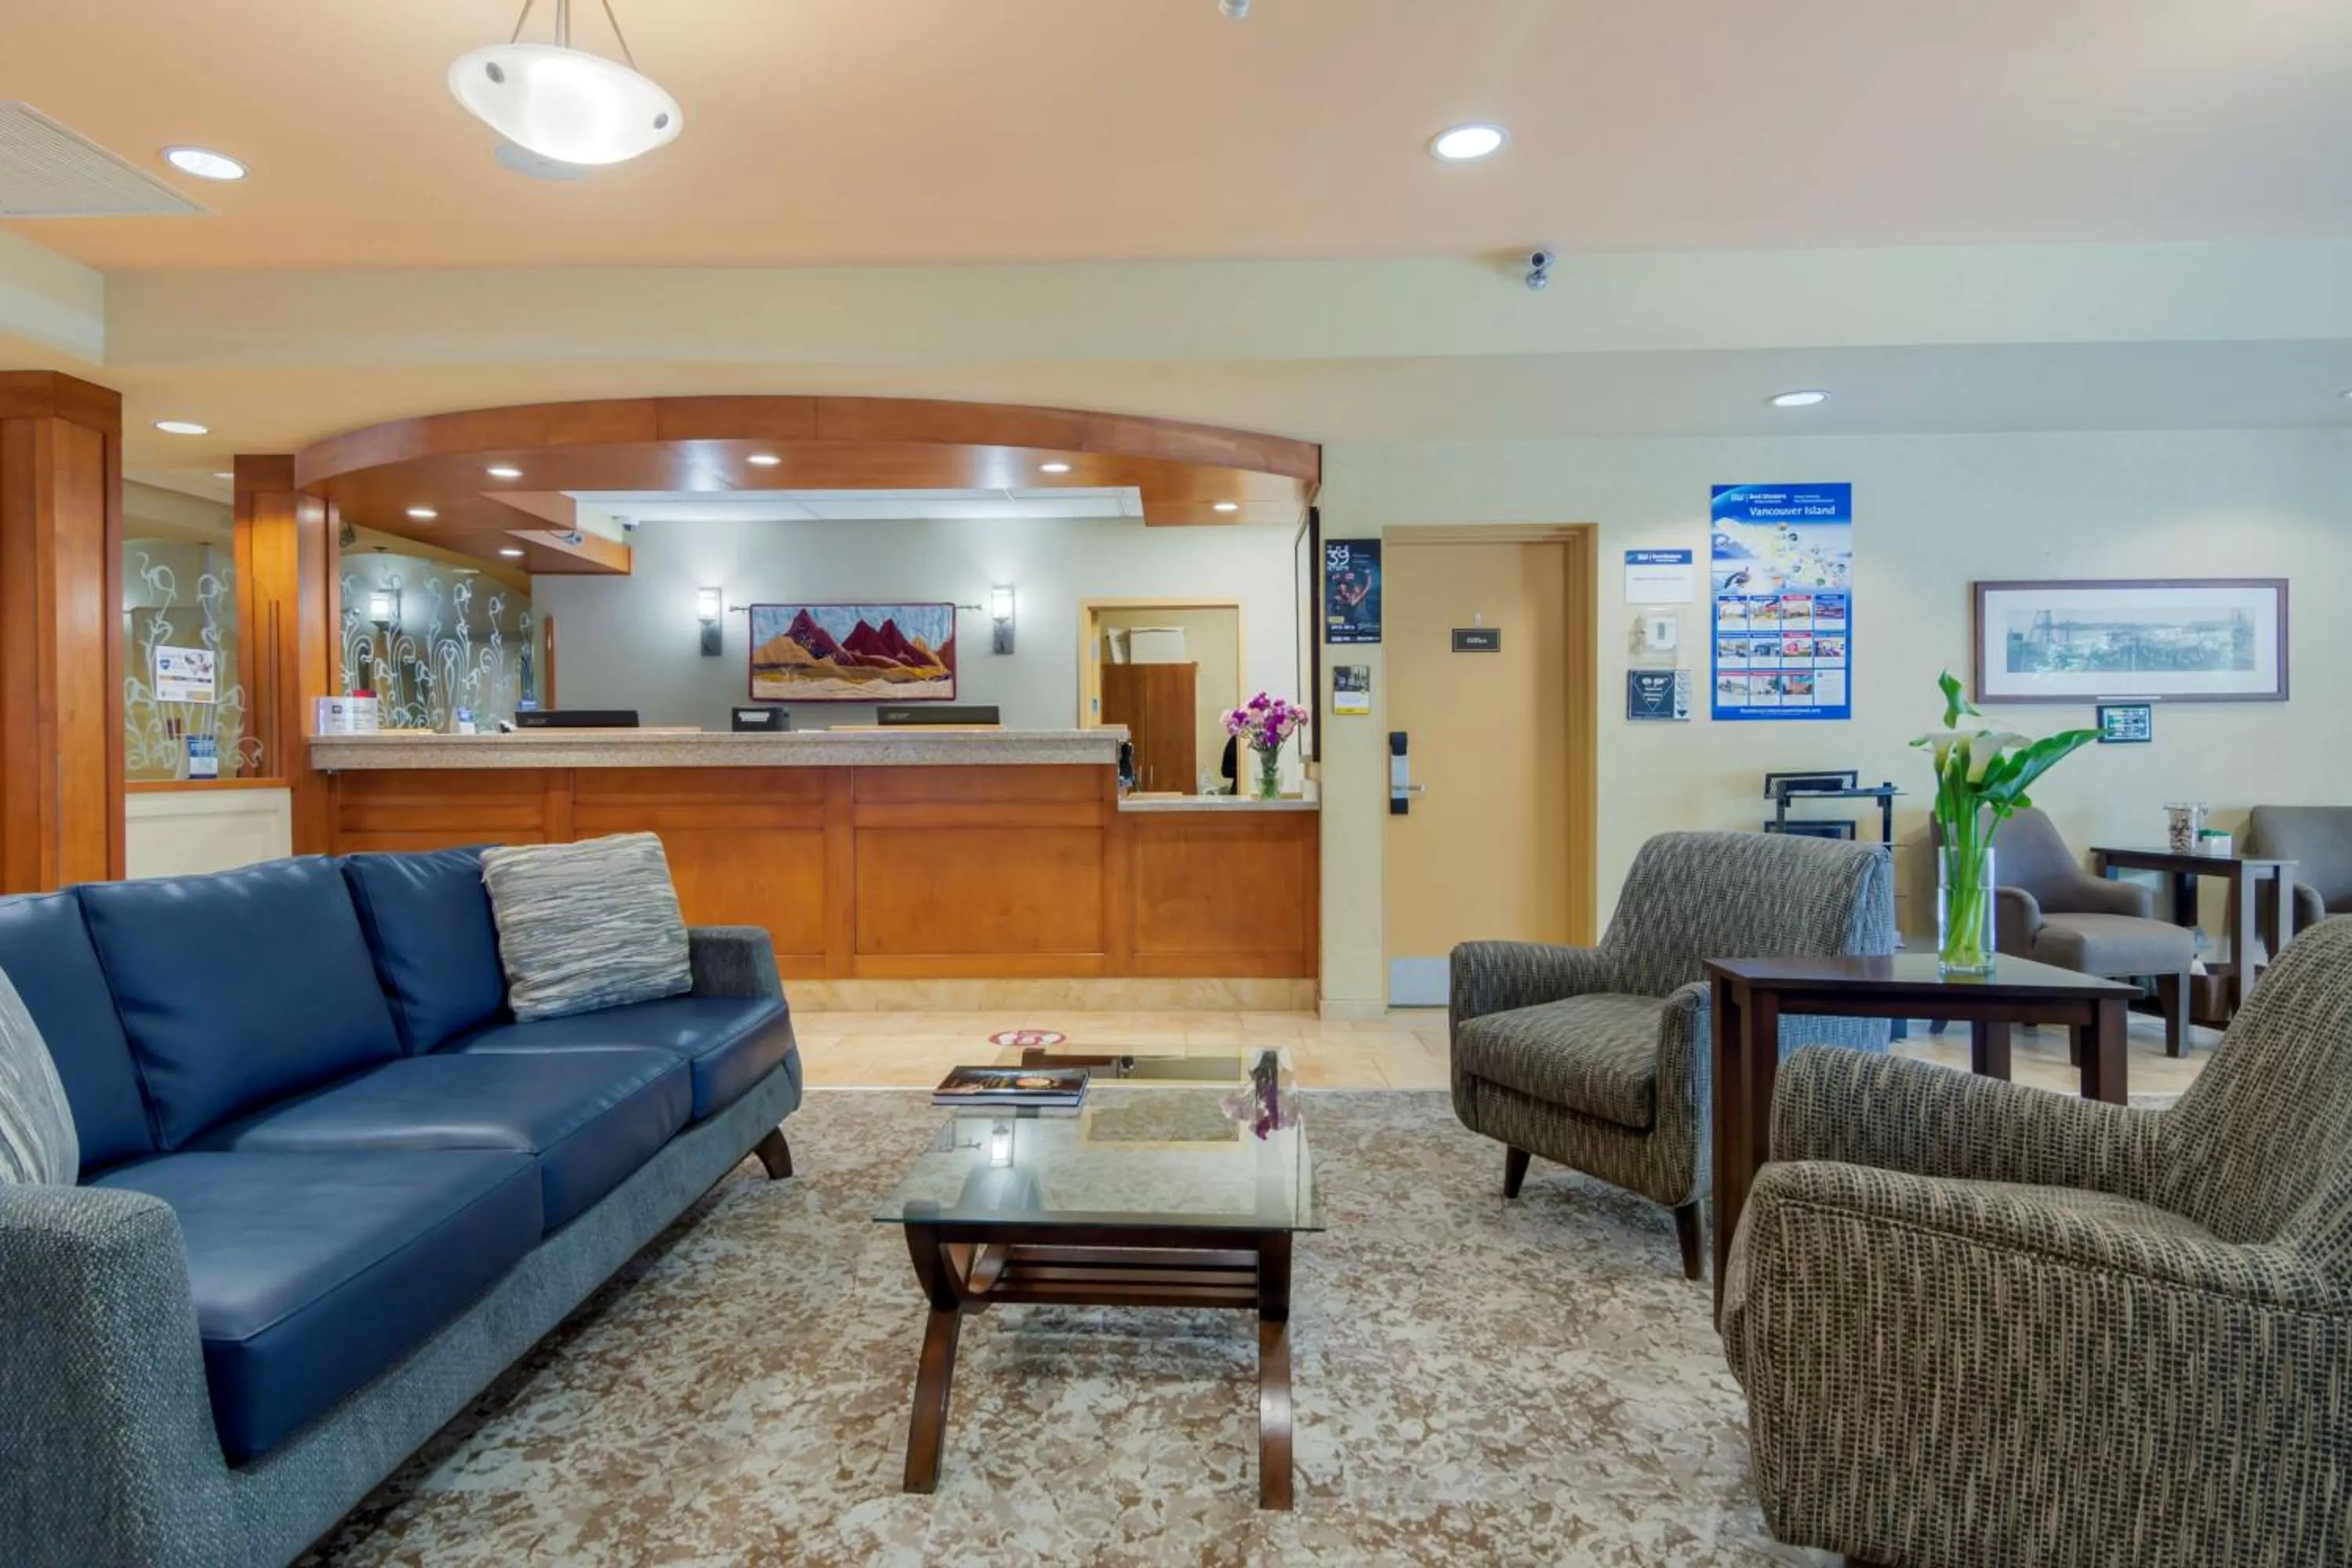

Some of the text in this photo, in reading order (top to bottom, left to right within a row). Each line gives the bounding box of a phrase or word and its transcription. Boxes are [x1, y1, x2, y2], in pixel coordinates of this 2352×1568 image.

[1749, 505, 1835, 516] Vancouver Island
[1327, 550, 1349, 565] 39
